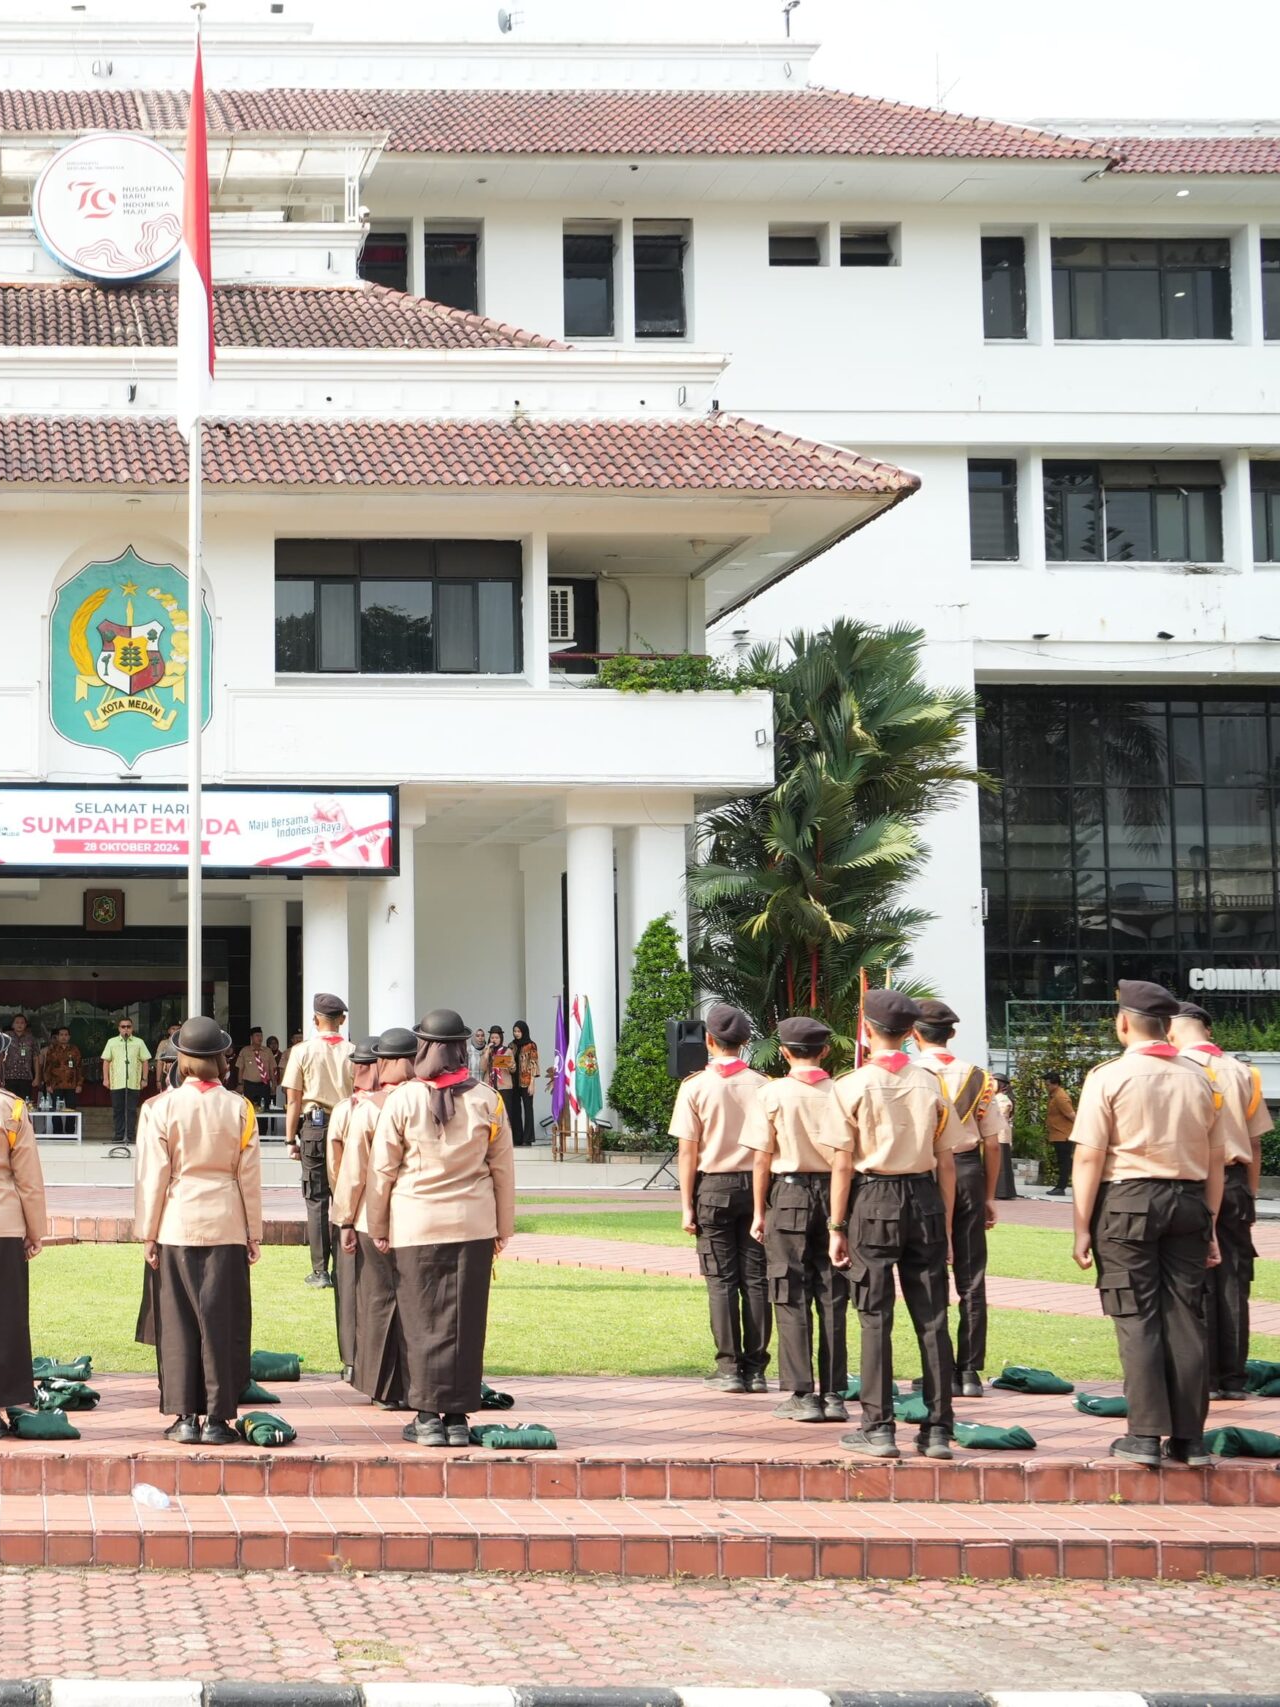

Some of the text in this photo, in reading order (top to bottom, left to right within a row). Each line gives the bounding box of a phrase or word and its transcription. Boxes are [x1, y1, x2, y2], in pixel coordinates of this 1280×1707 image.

[67, 181, 118, 219] 79
[101, 699, 161, 716] KOTA MEDAN
[74, 802, 190, 815] SELAMAT HARI
[22, 816, 241, 836] SUMPAH PEMDA
[248, 814, 309, 832] Maju Bersama
[276, 821, 341, 838] Indonesia Raya
[83, 842, 180, 853] 28 OKTOBER 2024
[1189, 968, 1280, 990] COMMAN
